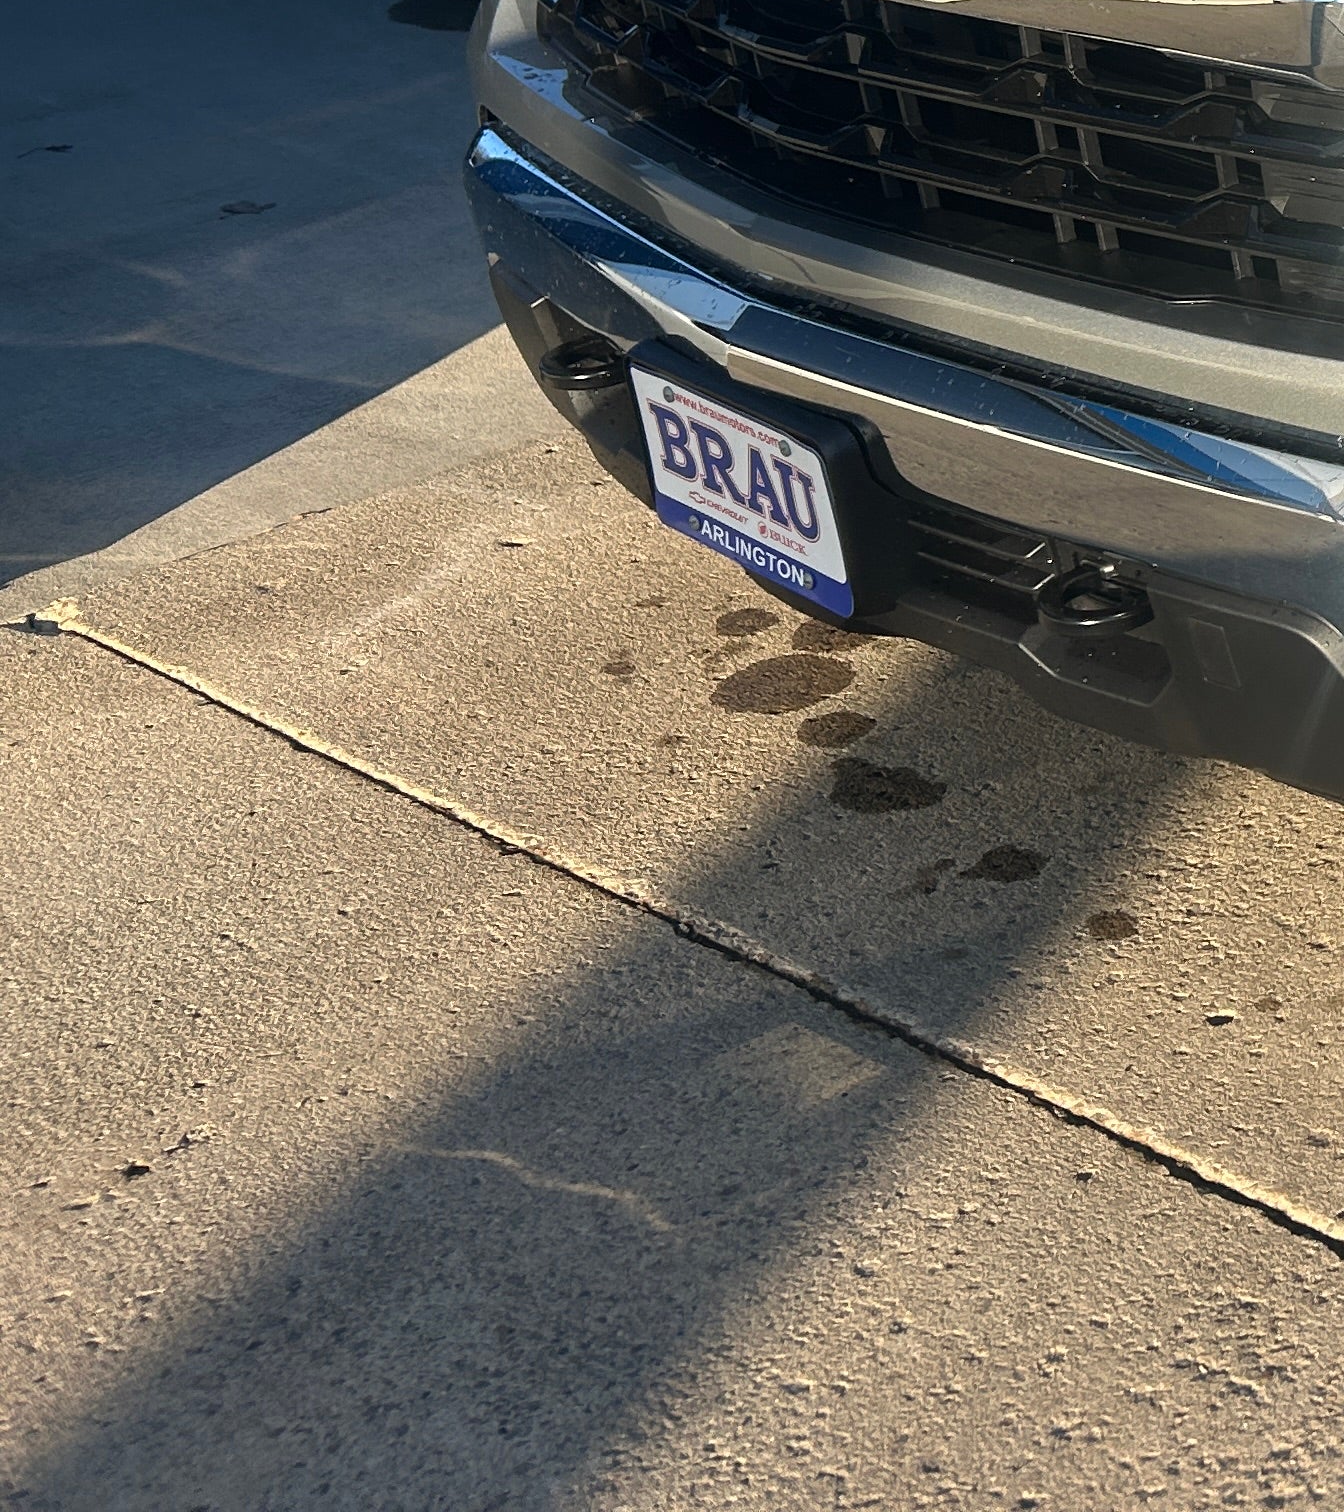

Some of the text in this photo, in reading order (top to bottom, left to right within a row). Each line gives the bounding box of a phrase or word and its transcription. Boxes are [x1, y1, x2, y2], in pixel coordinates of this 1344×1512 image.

[646, 398, 821, 544] BRAU
[706, 499, 749, 524] CHEVROLET
[701, 519, 805, 587] ARLINGTON
[769, 528, 809, 557] BUICK
